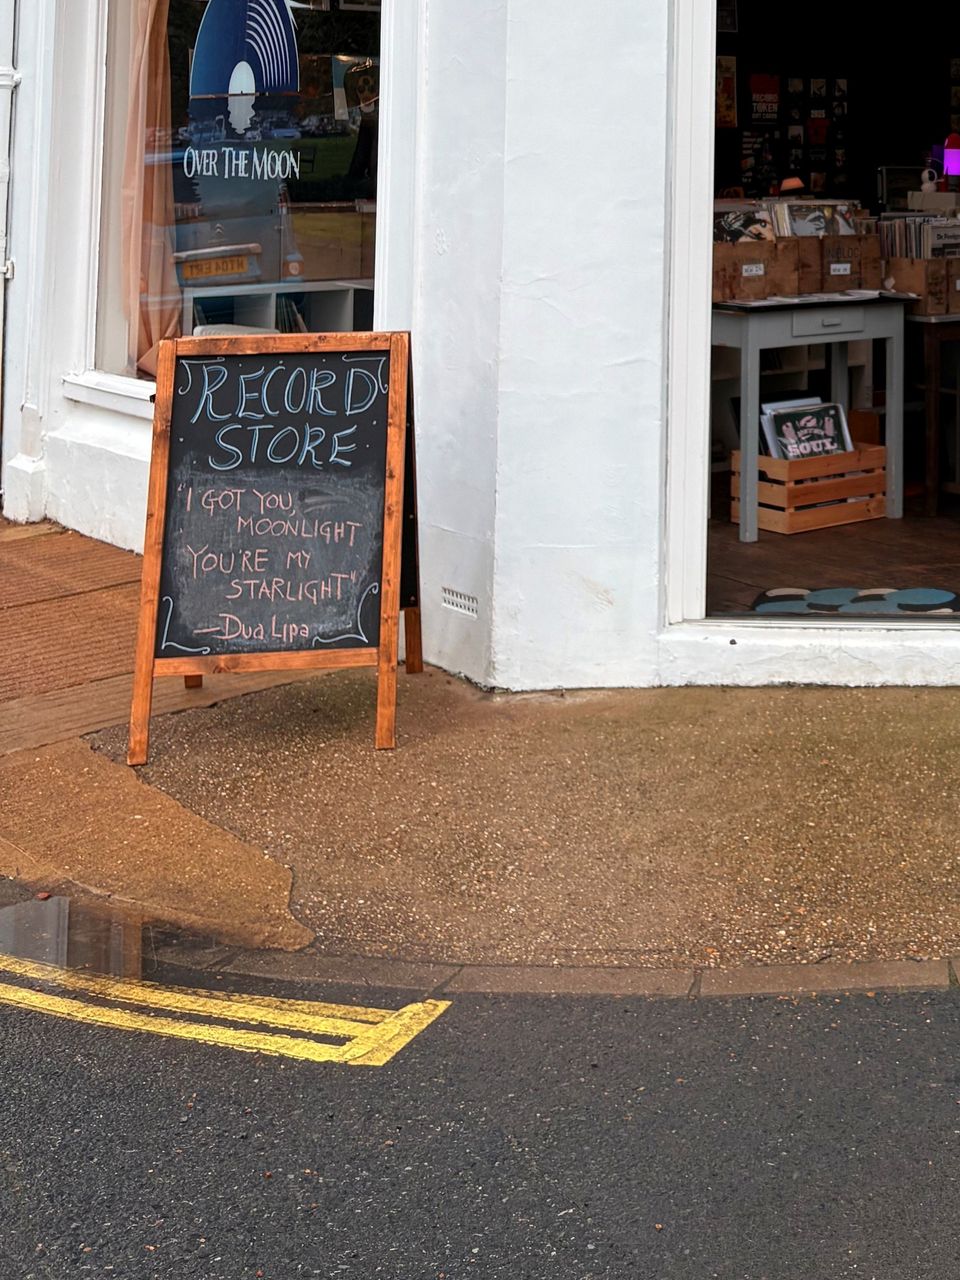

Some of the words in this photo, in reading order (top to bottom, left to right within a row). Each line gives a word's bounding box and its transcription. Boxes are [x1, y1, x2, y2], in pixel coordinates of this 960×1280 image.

[183, 145, 219, 178] OVER
[221, 146, 249, 179] THE
[251, 146, 301, 180] MOON
[190, 364, 379, 424] RECORD
[208, 423, 358, 470] STORE
[787, 438, 838, 457] SOUL
[201, 488, 246, 516] GOT
[252, 488, 296, 517] YOU,
[237, 516, 363, 547] MOONLIGHT
[186, 544, 269, 579] YOU'RE
[286, 550, 312, 569] MY
[271, 614, 309, 643] Lipa
